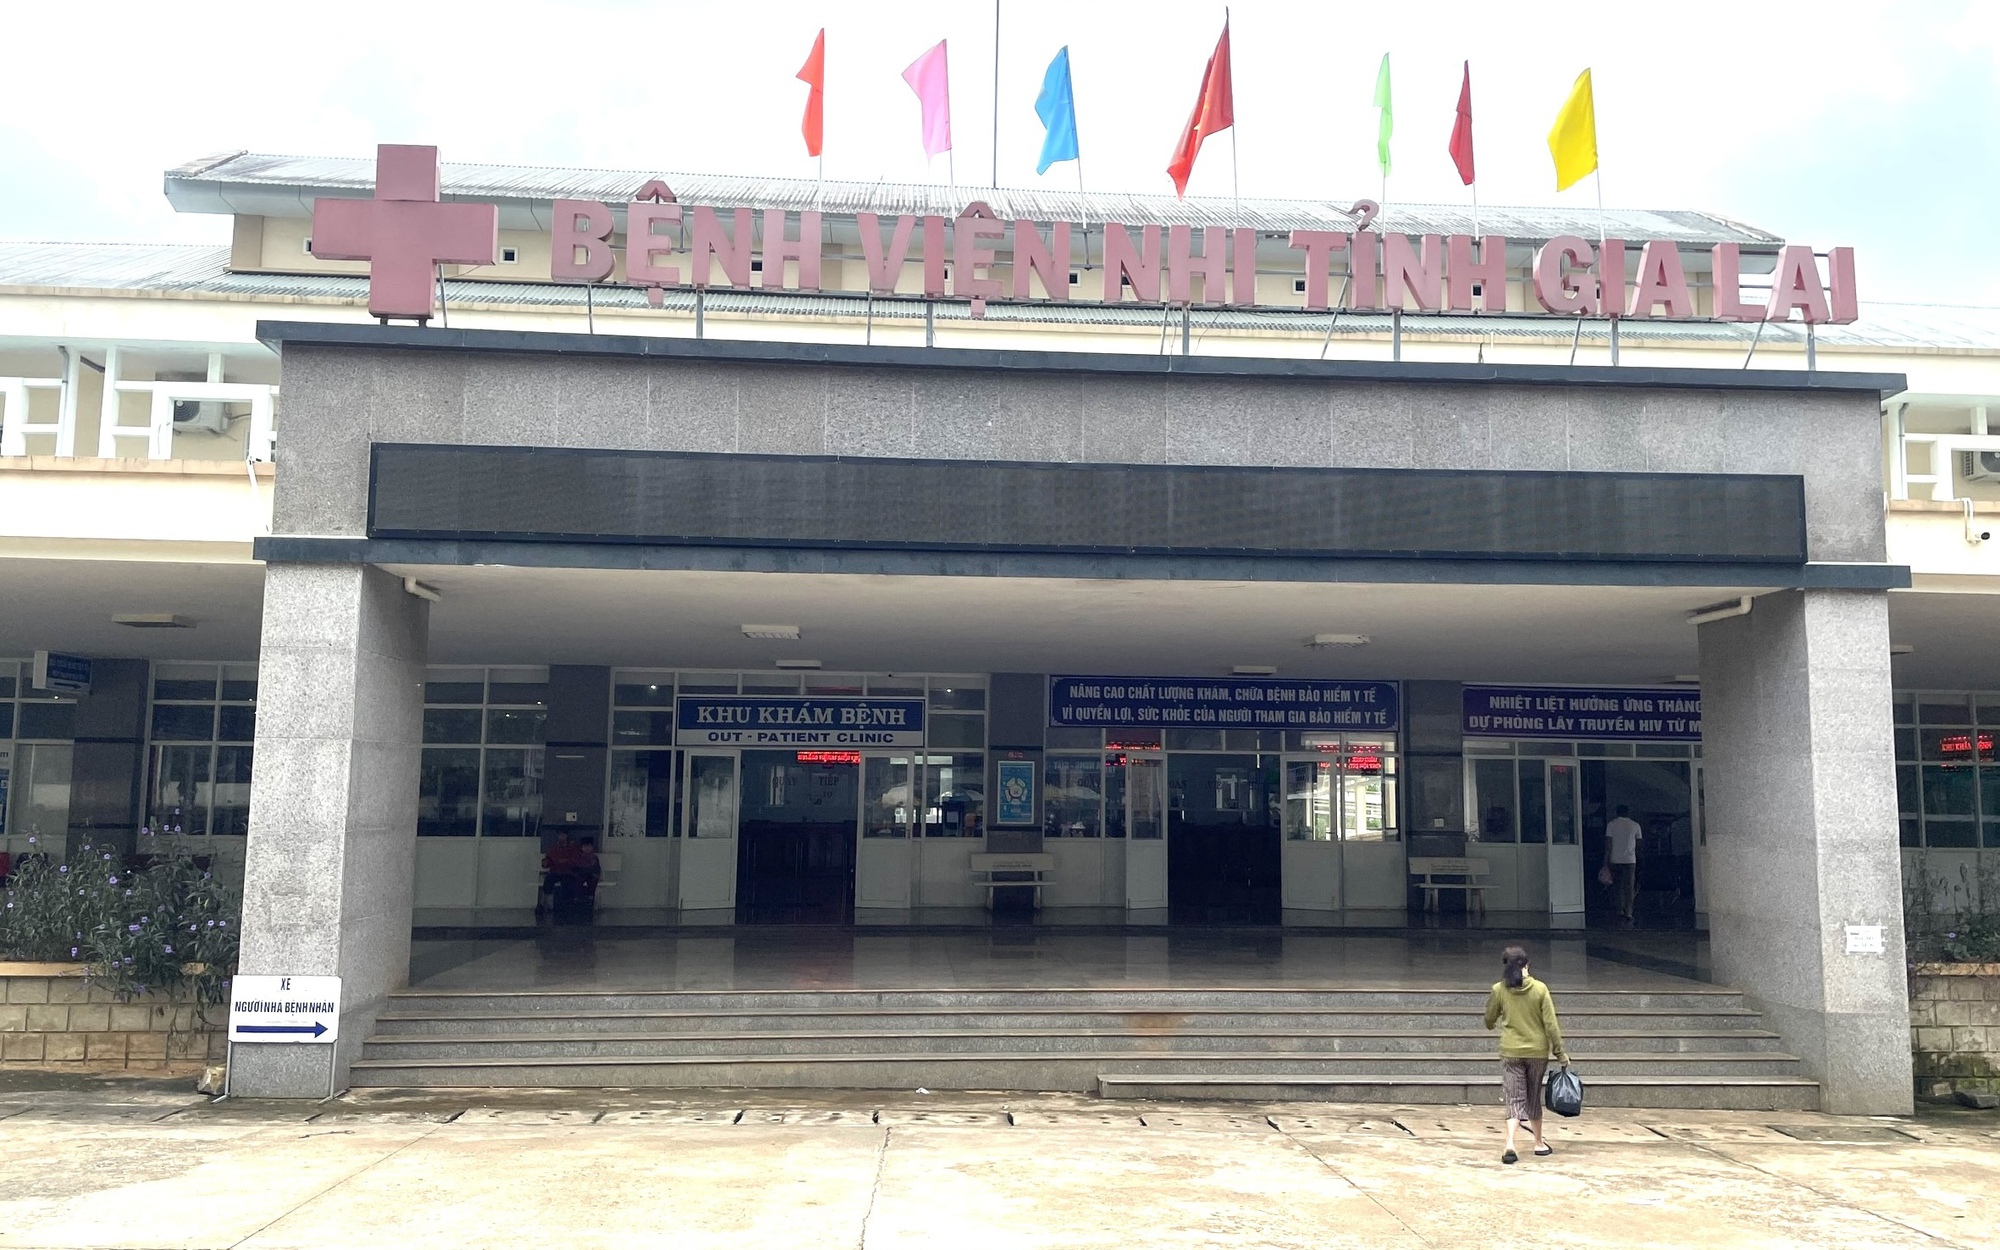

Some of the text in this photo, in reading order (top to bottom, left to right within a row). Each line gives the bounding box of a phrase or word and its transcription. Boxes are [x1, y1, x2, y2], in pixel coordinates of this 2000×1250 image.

[551, 179, 1859, 325] BỆNH VIỆN NHI TỈNH GIA LAI
[1070, 683, 1376, 704] NÂNG CAO CHẤT LƯỢNG KHÁM, CHỮA BỆNH BẢO HIỂM Y TẾ
[1489, 695, 1532, 712] NHIỆT
[1536, 696, 1565, 713] LIỆT
[1569, 694, 1619, 712] HƯỞNG
[1623, 696, 1653, 713] ỨNG
[697, 702, 906, 730] KHU KHÁM BỆNH
[1061, 703, 1387, 724] VÌ QUYỀN LỢI, SỨC KHỎE CỦA NGƯỜI THAM GIA BẢO HIỂM Y TẾ
[1469, 715, 1491, 732] DỰ
[1493, 715, 1544, 730] PHÒNG
[1548, 715, 1575, 730] LÂY
[1579, 715, 1635, 732] TRUYỀN
[1639, 719, 1662, 732] HIV
[1667, 717, 1687, 733] TỪ
[707, 731, 743, 742] OUT
[757, 732, 831, 743] PATIENT
[836, 732, 895, 744] CLINIC
[280, 978, 291, 991] XE
